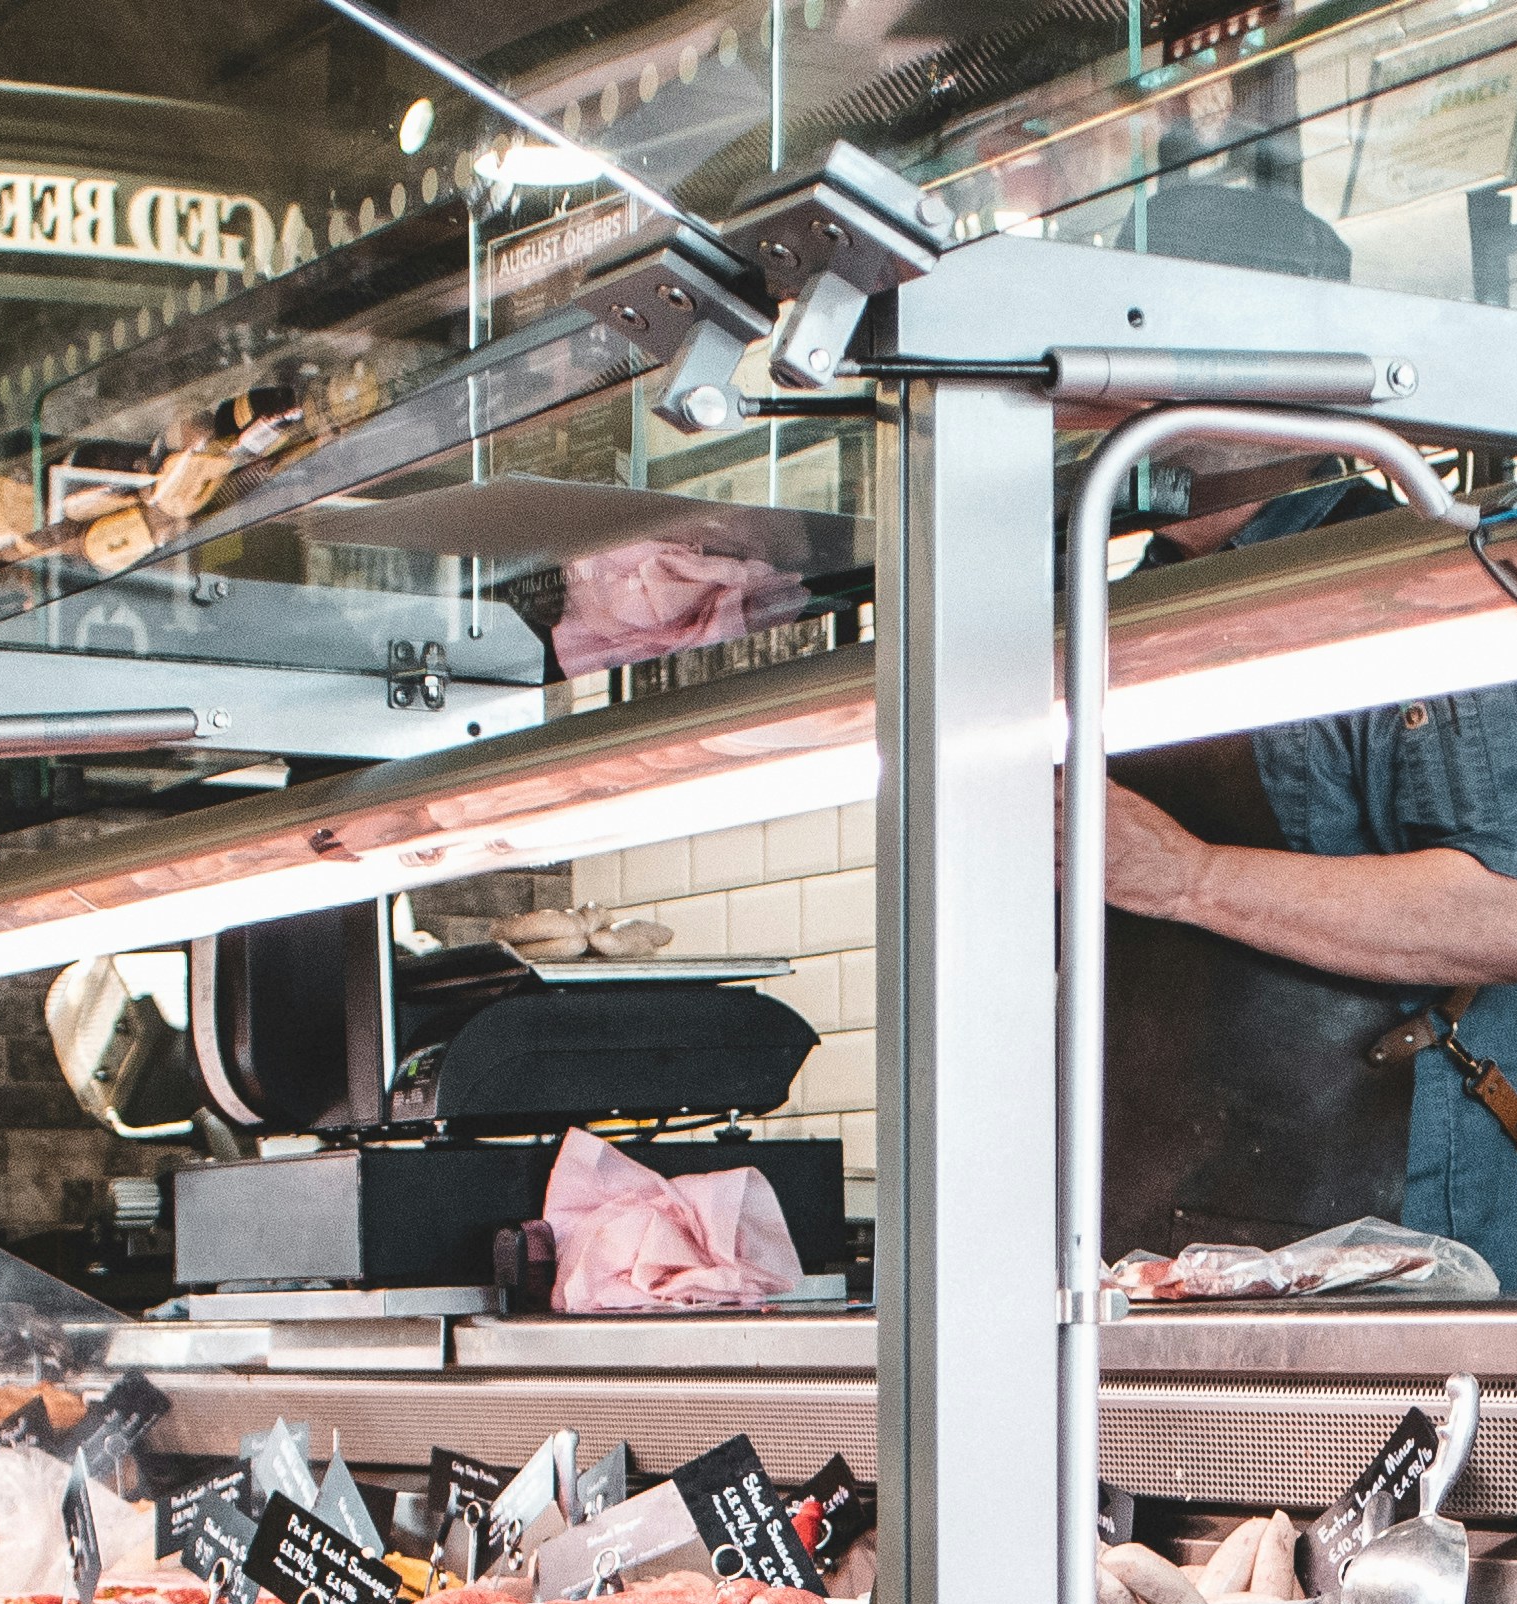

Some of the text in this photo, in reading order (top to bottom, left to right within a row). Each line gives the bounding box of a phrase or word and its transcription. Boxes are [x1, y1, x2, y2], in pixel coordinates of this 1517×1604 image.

[499, 211, 623, 279] AUGUST OFFERS
[742, 1472, 775, 1521] Steak
[766, 1518, 804, 1590] Sausages
[1316, 1437, 1416, 1545] Extra Lean Mince
[287, 1513, 311, 1542] Pork
[310, 1531, 323, 1552] &
[322, 1537, 347, 1568] Leek
